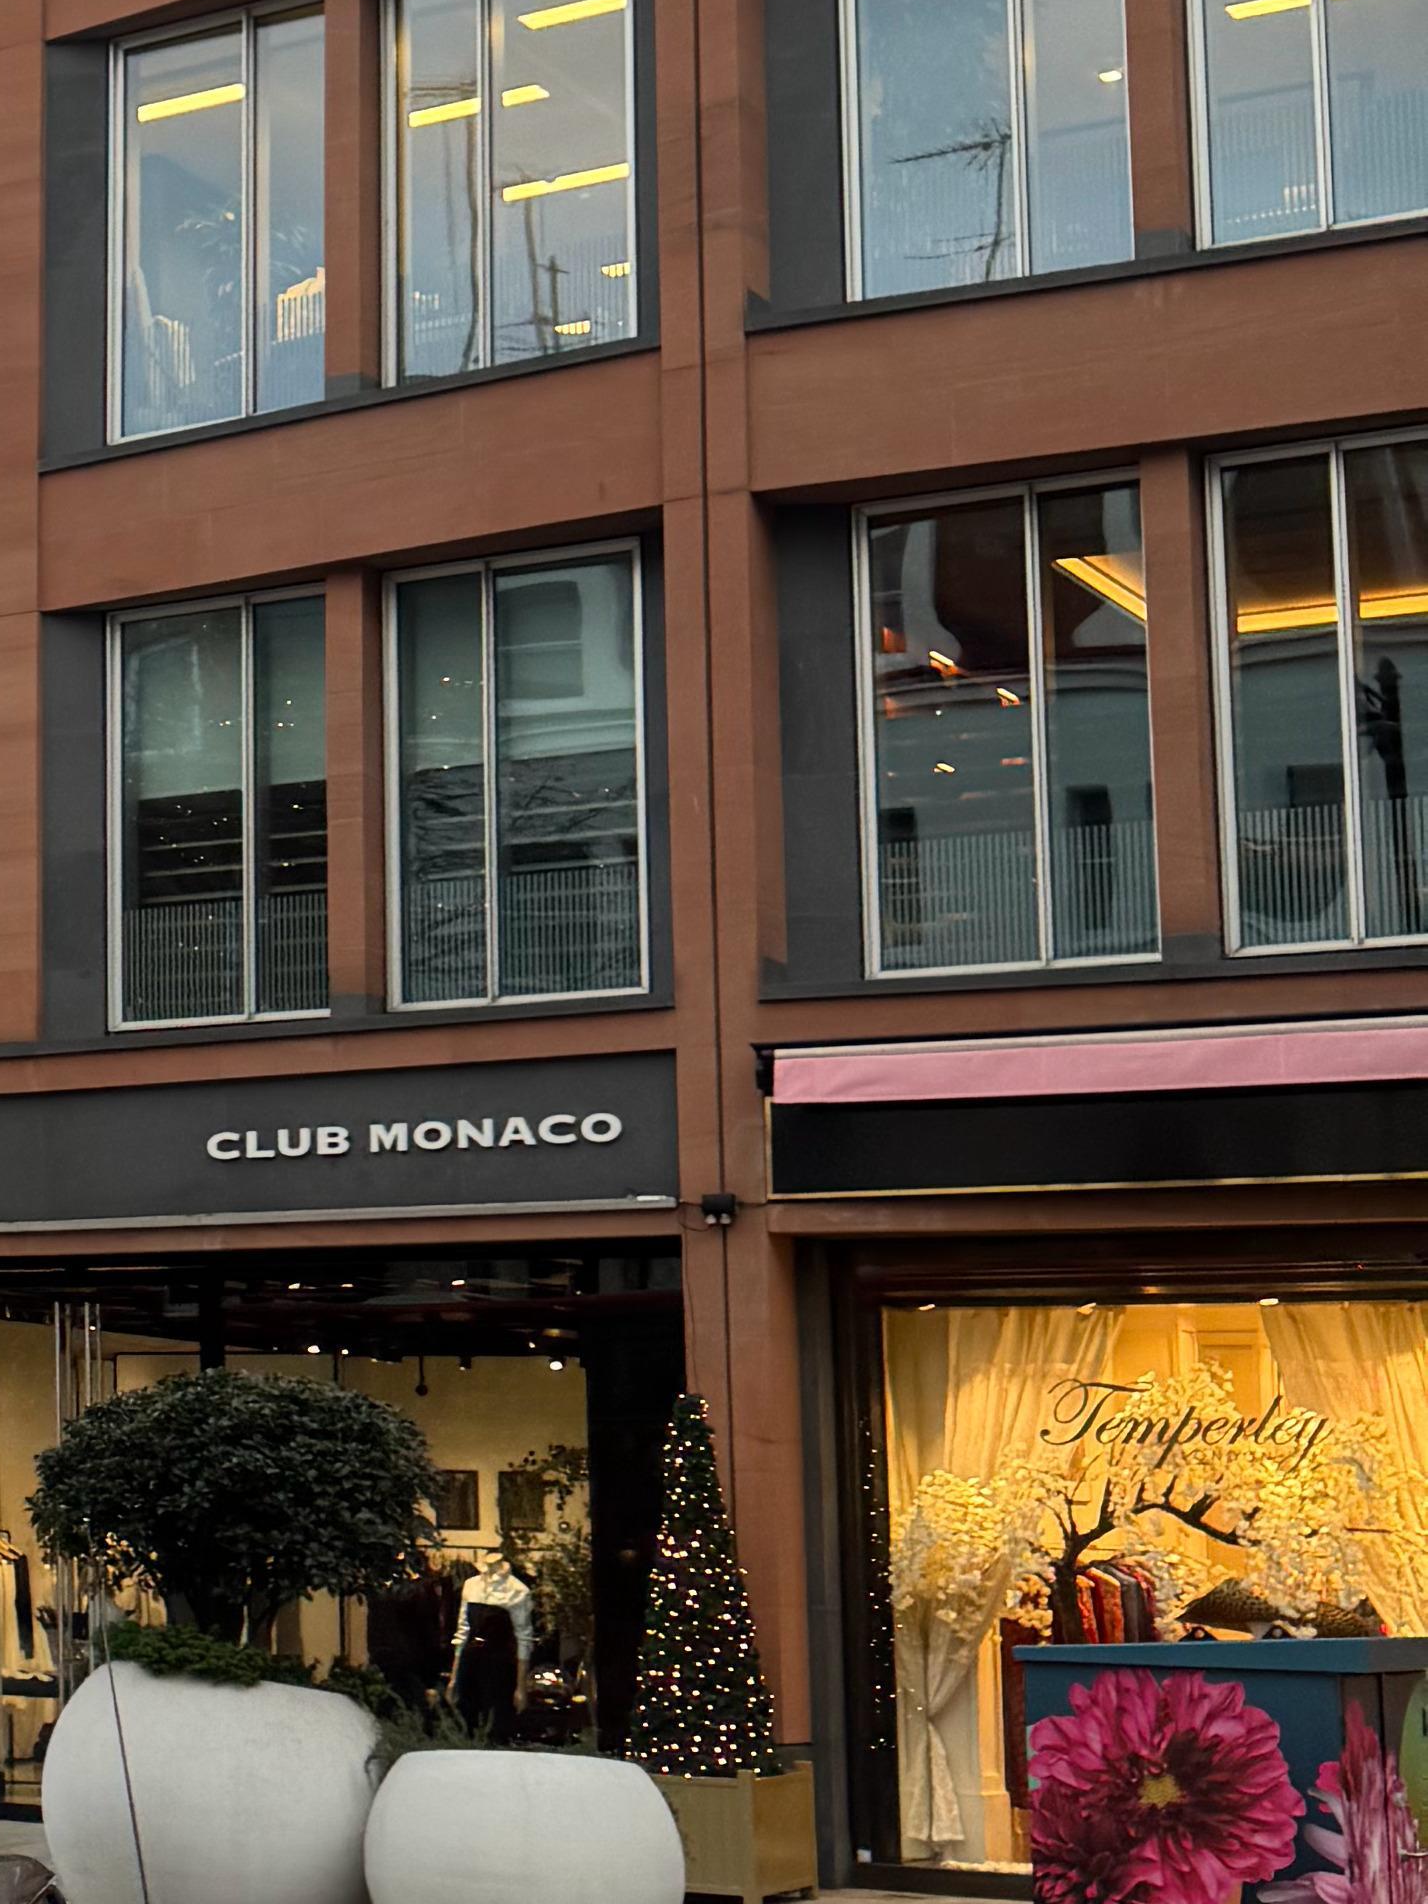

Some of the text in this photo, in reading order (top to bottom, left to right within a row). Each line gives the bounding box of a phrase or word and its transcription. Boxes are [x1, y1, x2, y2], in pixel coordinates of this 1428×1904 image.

[206, 1112, 622, 1160] CLUB MONACO
[1040, 1378, 1334, 1476] Temperley
